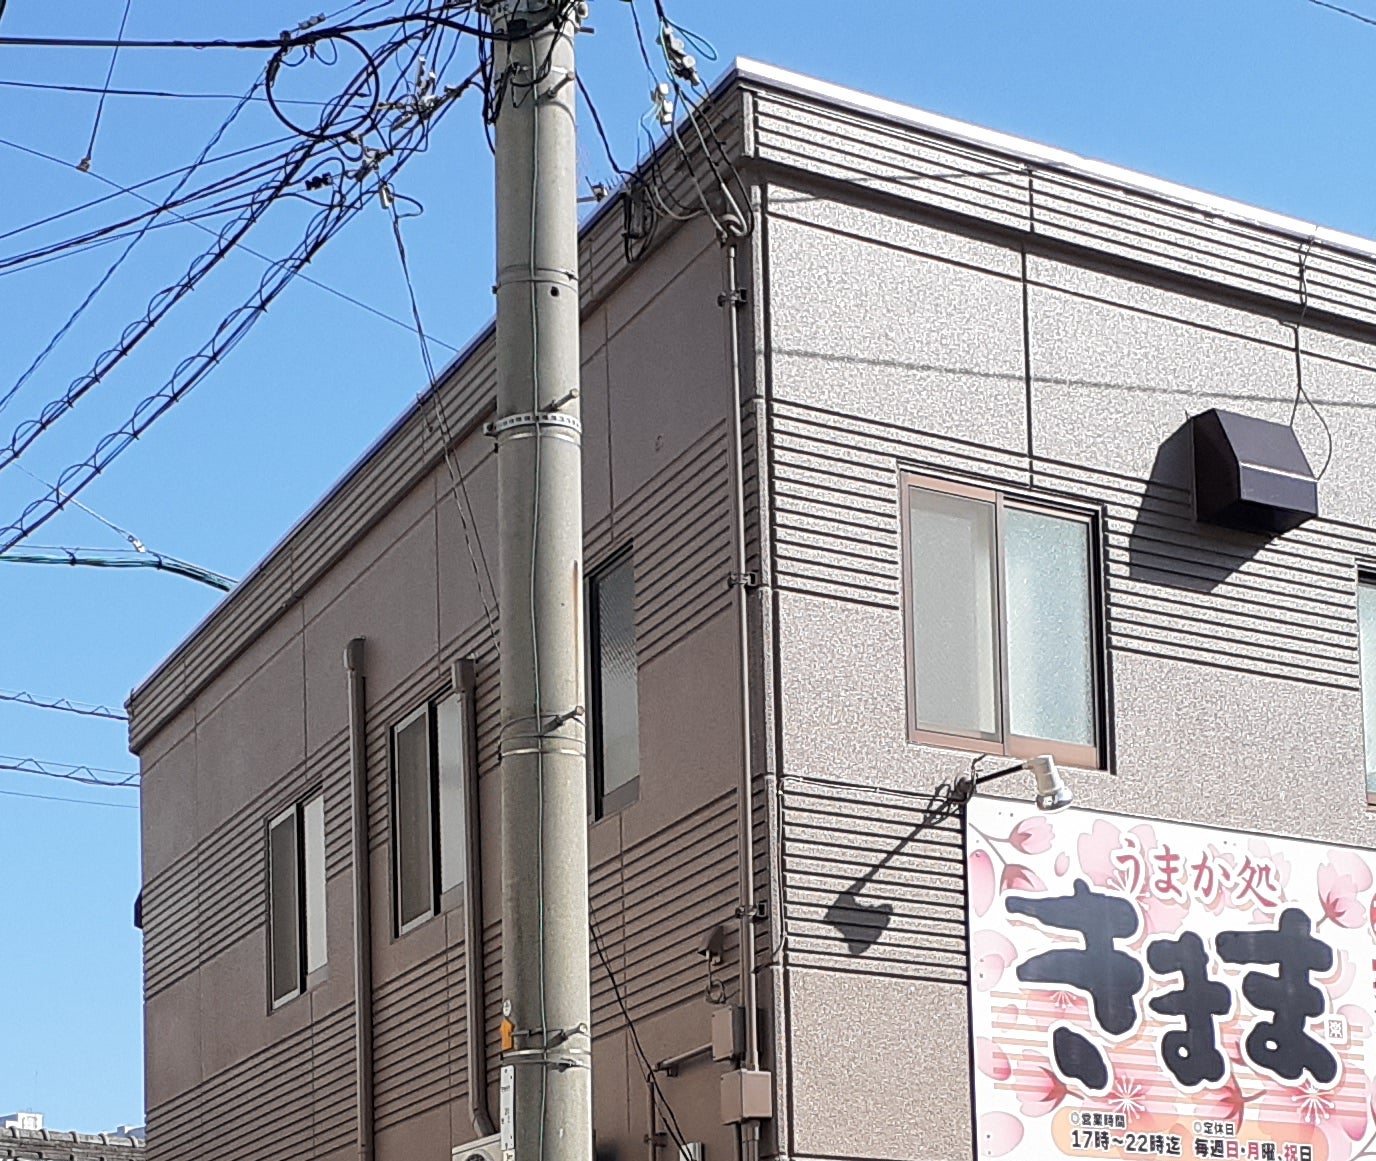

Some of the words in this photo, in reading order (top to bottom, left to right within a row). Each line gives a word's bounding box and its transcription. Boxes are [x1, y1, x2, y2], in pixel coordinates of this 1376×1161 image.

[1115, 837, 1279, 908] うまか処
[1004, 878, 1338, 1090] きまま
